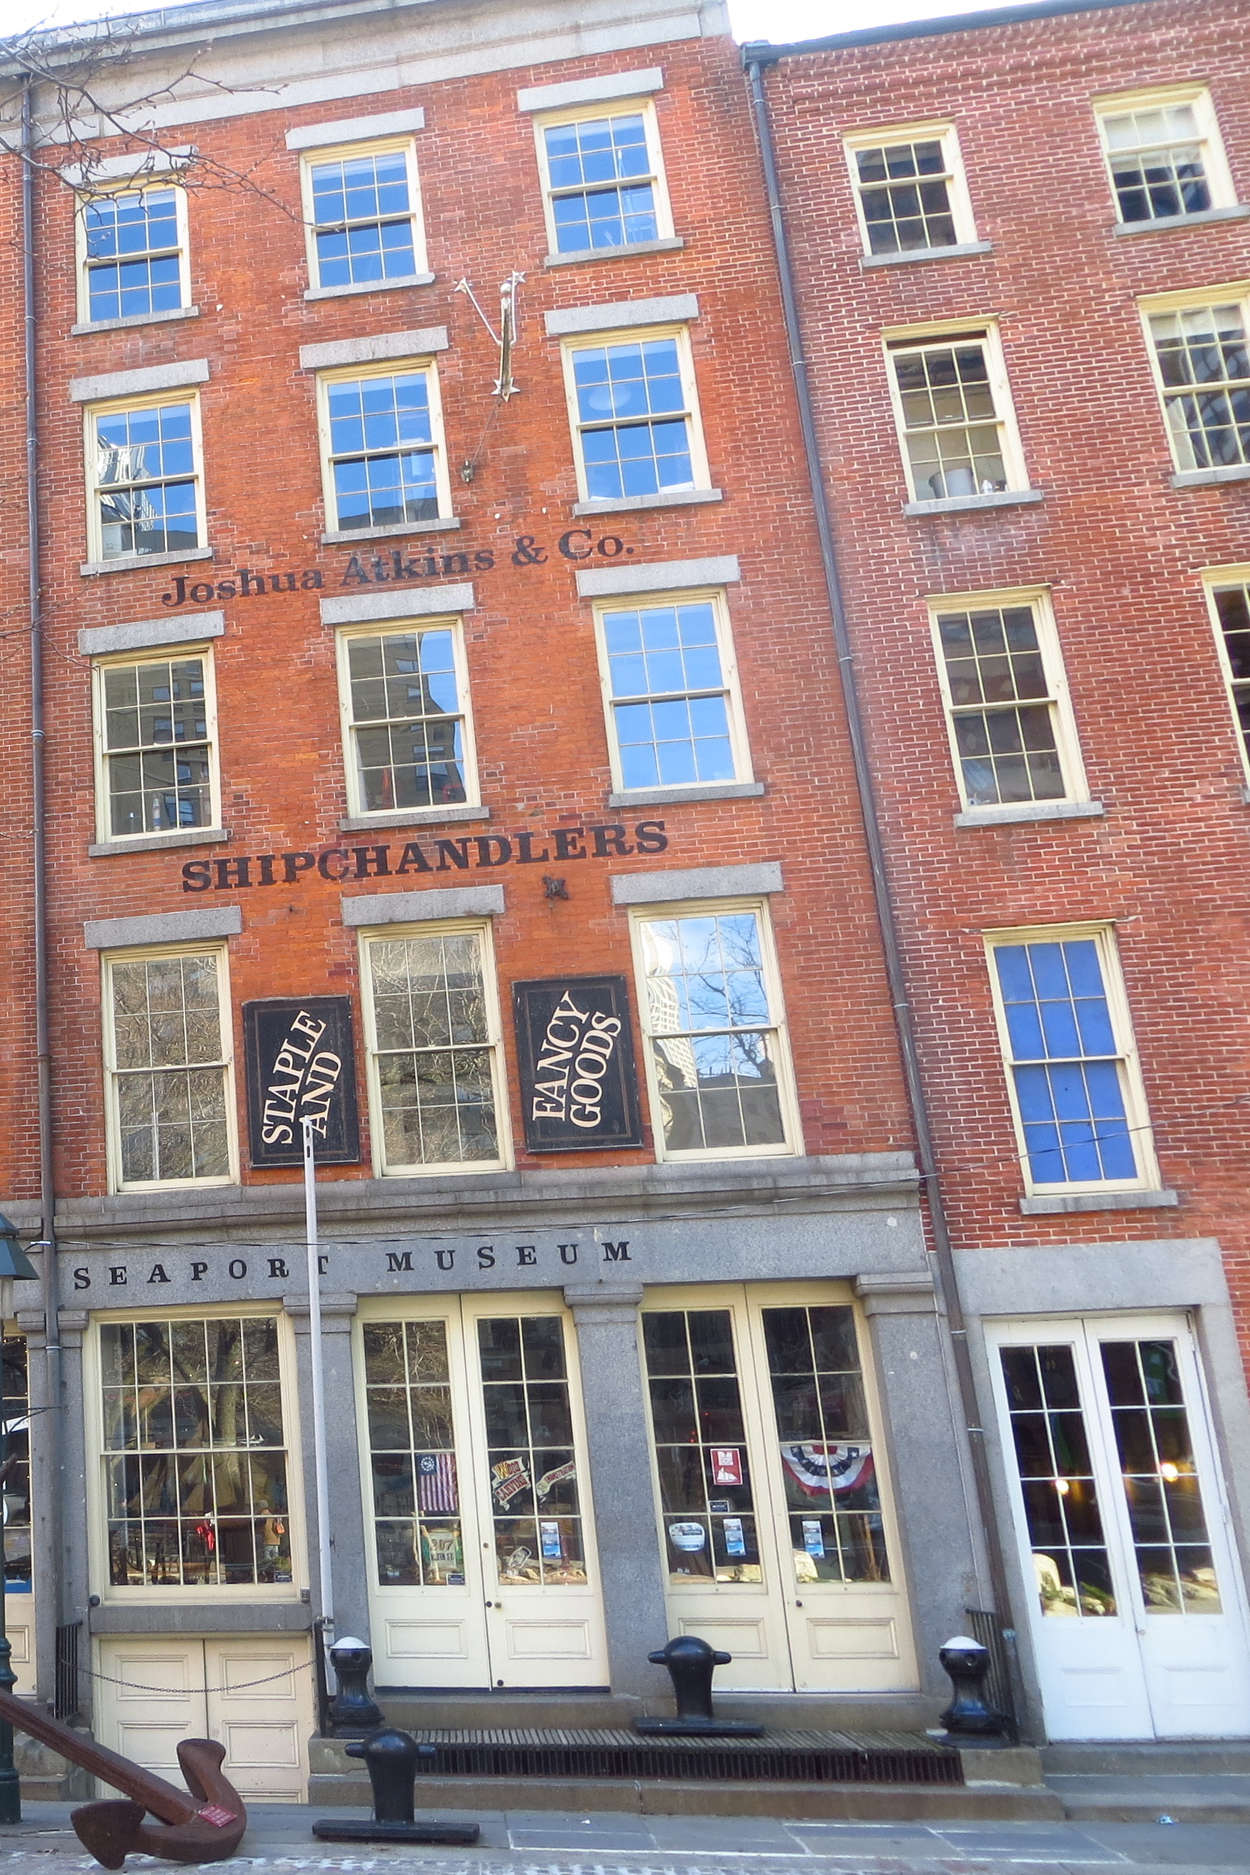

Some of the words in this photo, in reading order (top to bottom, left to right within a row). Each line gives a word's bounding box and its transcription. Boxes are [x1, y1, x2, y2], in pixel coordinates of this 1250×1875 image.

[161, 568, 325, 607] Joshua
[340, 547, 495, 586] Atkins
[511, 535, 548, 567] &
[559, 529, 635, 561] Co.
[181, 820, 668, 893] SHIPCHANDLERS
[261, 1009, 327, 1146] STAPLE
[298, 1050, 343, 1139] AND
[531, 990, 591, 1122] FANCY
[570, 1010, 622, 1129] GOODS
[385, 1241, 632, 1273] MUSEUM
